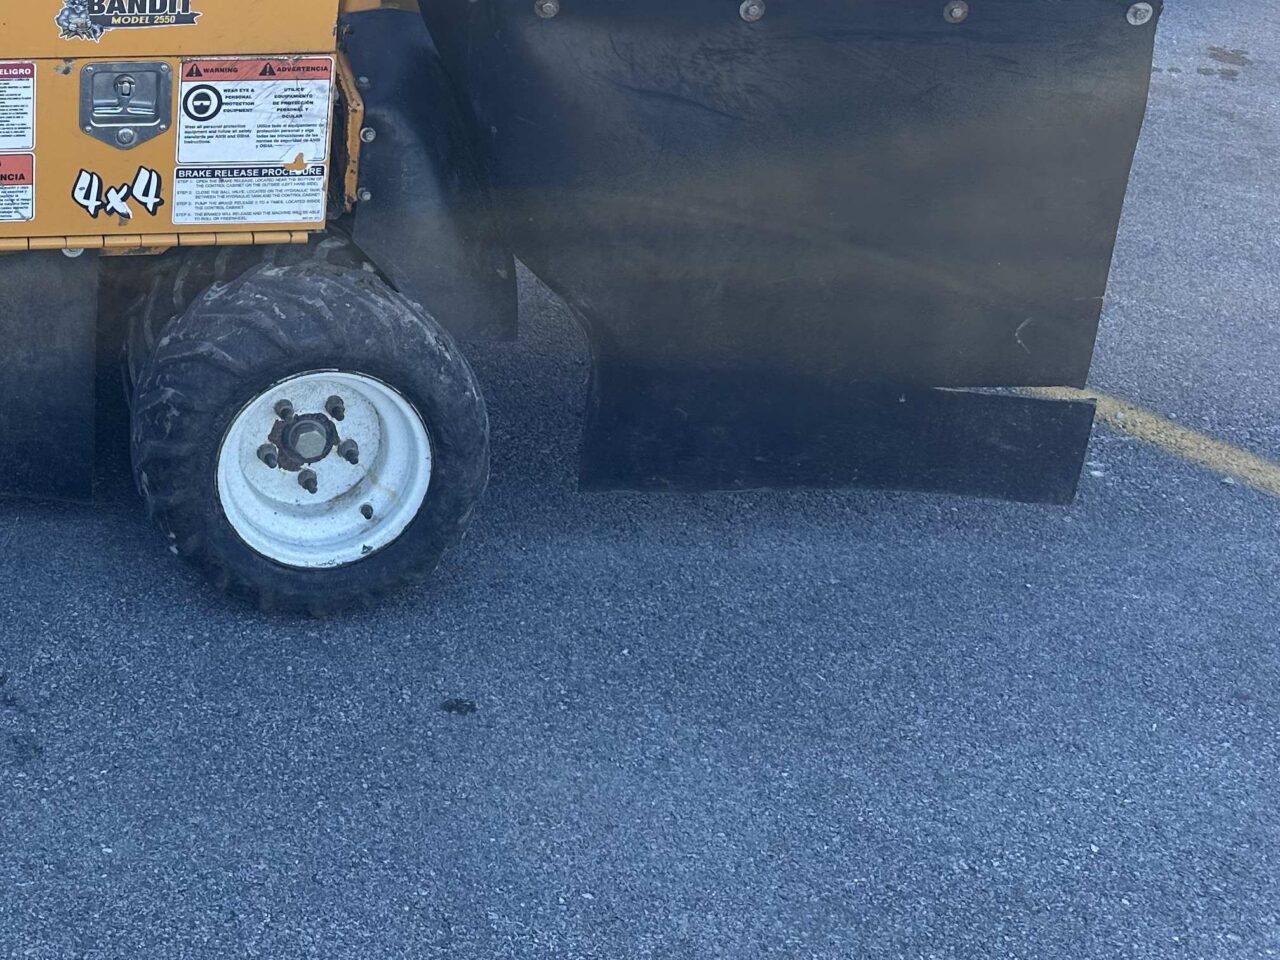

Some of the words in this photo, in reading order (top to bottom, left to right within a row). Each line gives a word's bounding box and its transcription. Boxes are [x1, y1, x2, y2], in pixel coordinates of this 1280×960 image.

[111, 16, 150, 24] MODEL
[154, 15, 176, 24] 2550
[178, 169, 212, 178] BRAKE
[214, 169, 259, 178] RELEASE
[72, 165, 164, 219] 4x4
